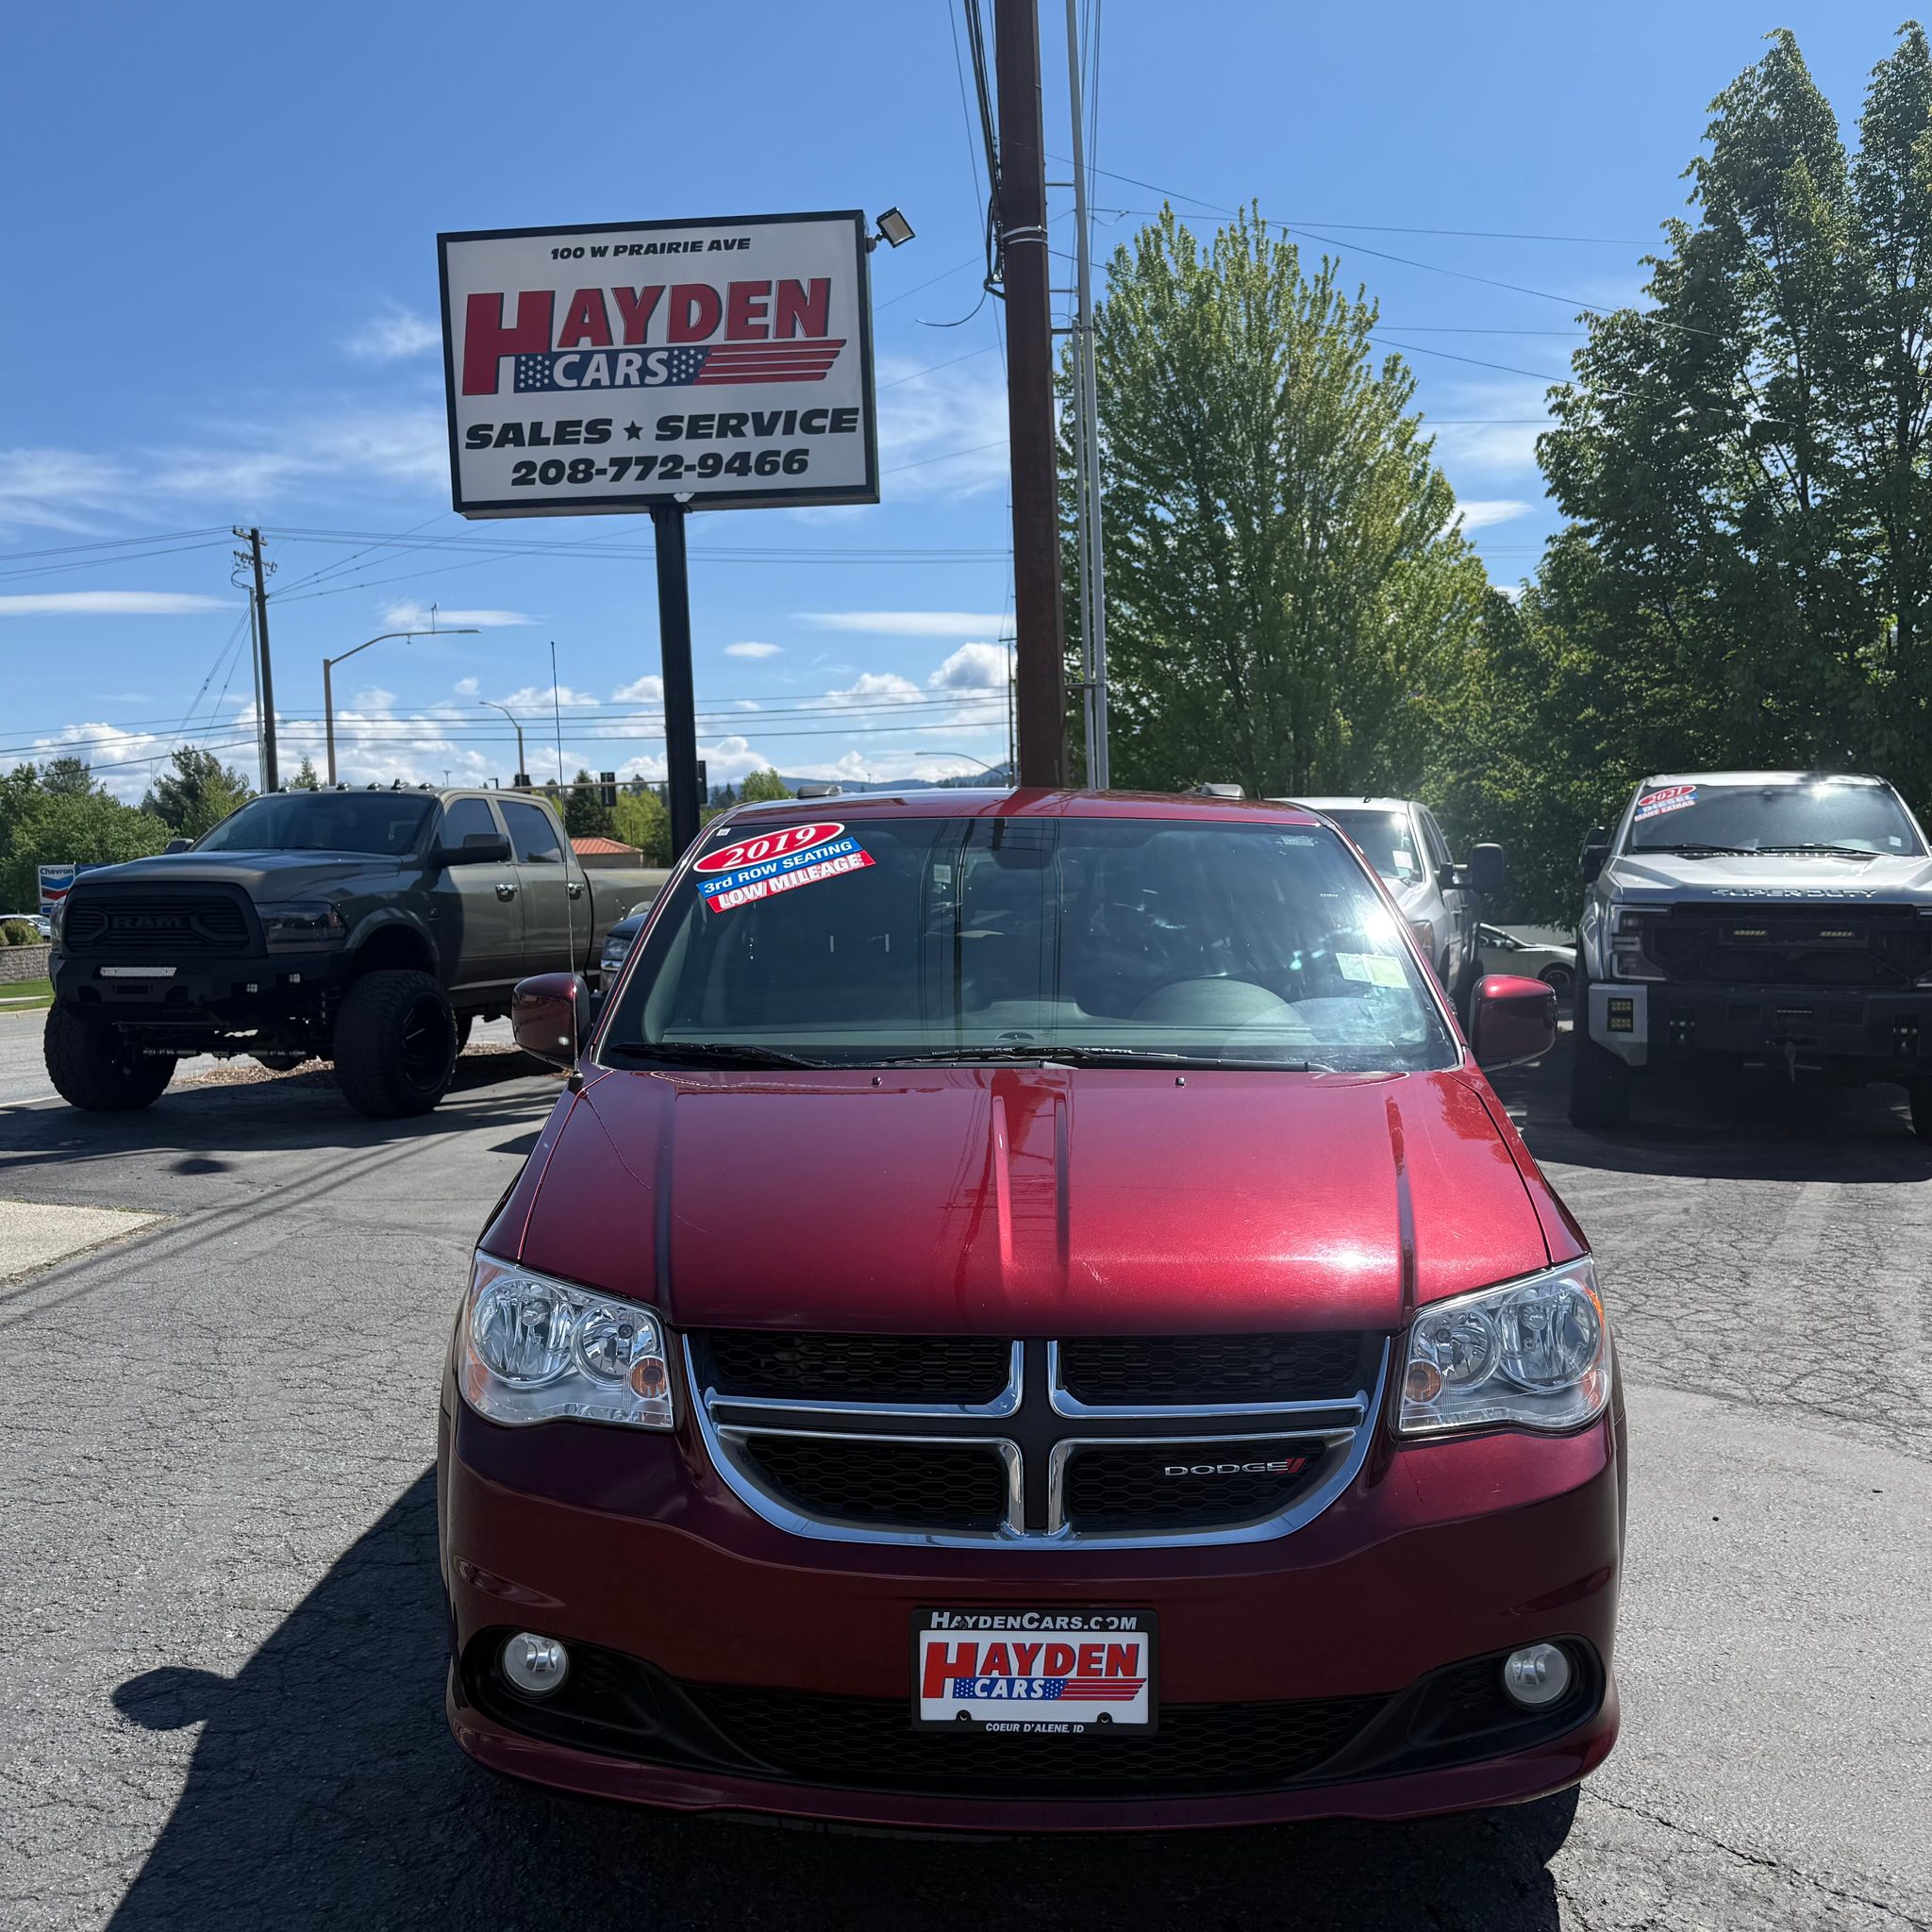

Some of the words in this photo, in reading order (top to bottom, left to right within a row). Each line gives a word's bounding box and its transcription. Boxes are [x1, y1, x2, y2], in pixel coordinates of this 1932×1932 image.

[551, 246, 585, 260] 100
[590, 245, 610, 258] W
[612, 240, 704, 258] PRAIRIE
[707, 238, 751, 252] AVE
[461, 277, 831, 396] HAYDEN
[552, 349, 669, 388] CARS
[465, 417, 613, 449] SALES
[655, 407, 859, 441] SERVICE
[510, 448, 809, 486] 208-772-9466
[1649, 787, 1683, 803] 2021
[723, 826, 817, 868] 2019
[40, 867, 74, 875] Chevron
[704, 876, 733, 893] 3rd
[739, 862, 777, 883] ROW
[782, 841, 853, 869] SEATING
[718, 881, 768, 909] LOW
[769, 853, 865, 892] MILEAGE
[1711, 889, 1802, 897] SUPER
[111, 915, 186, 929] RAM
[1164, 1461, 1290, 1476] DODGE
[922, 1641, 1141, 1699] HAYDEN
[974, 1678, 1045, 1699] CARS
[985, 1723, 1020, 1732] COEUR
[1024, 1724, 1070, 1733] D'ALENE,
[1073, 1724, 1085, 1733] ID
